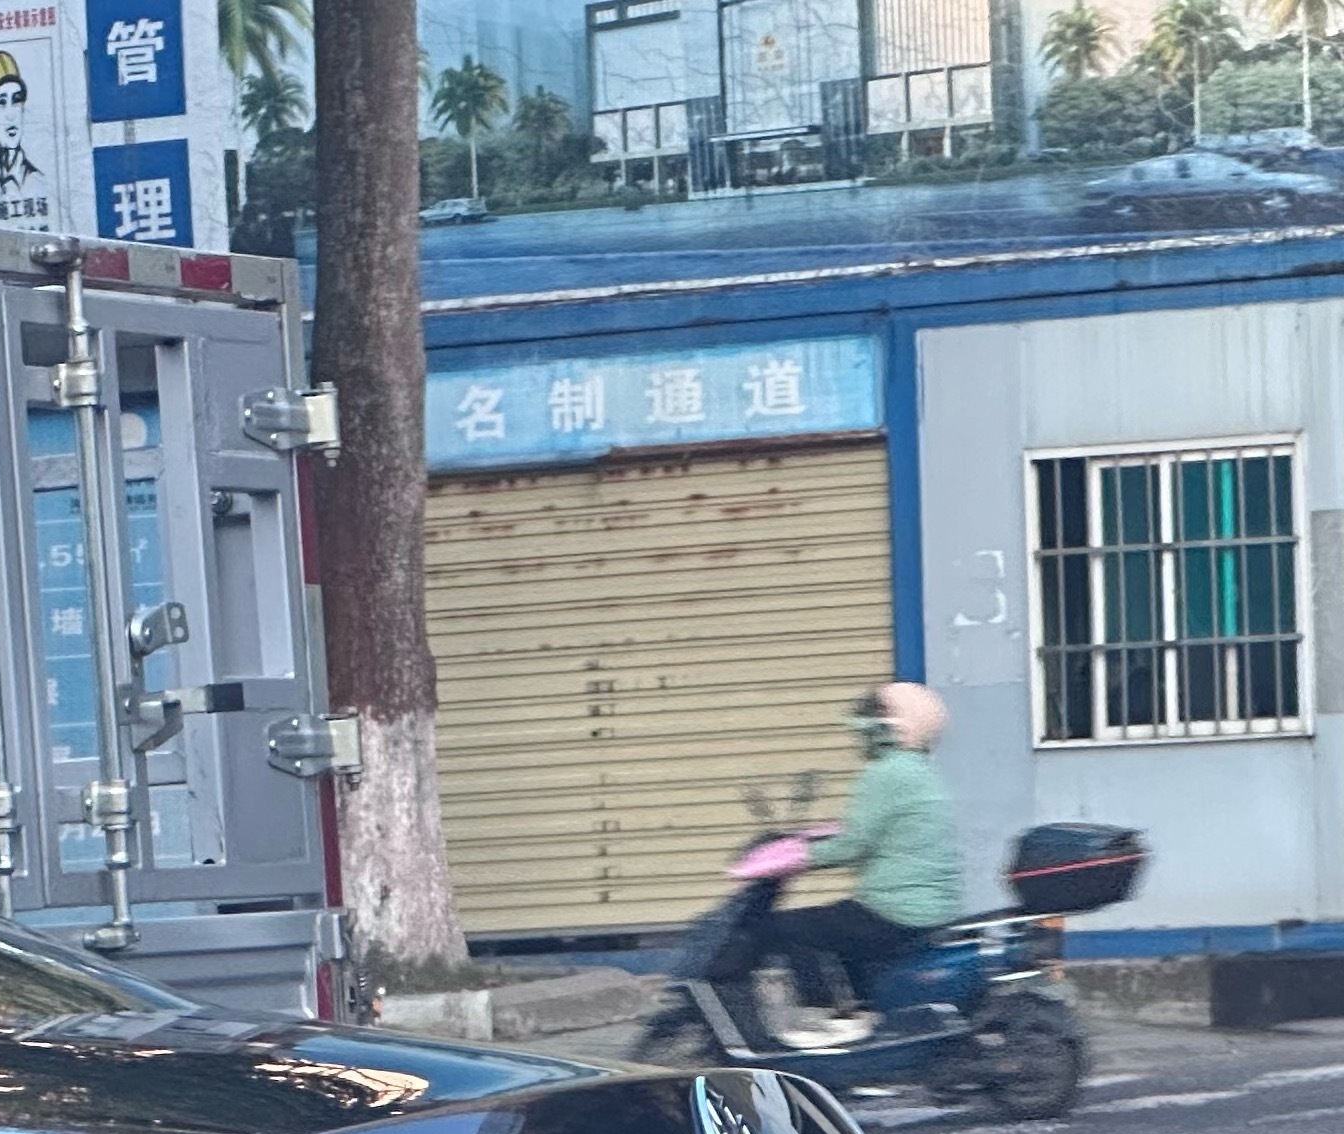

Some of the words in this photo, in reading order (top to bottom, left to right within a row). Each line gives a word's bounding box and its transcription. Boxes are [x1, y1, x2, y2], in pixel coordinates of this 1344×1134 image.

[107, 18, 176, 241] 管理
[456, 361, 806, 439] 名制通道
